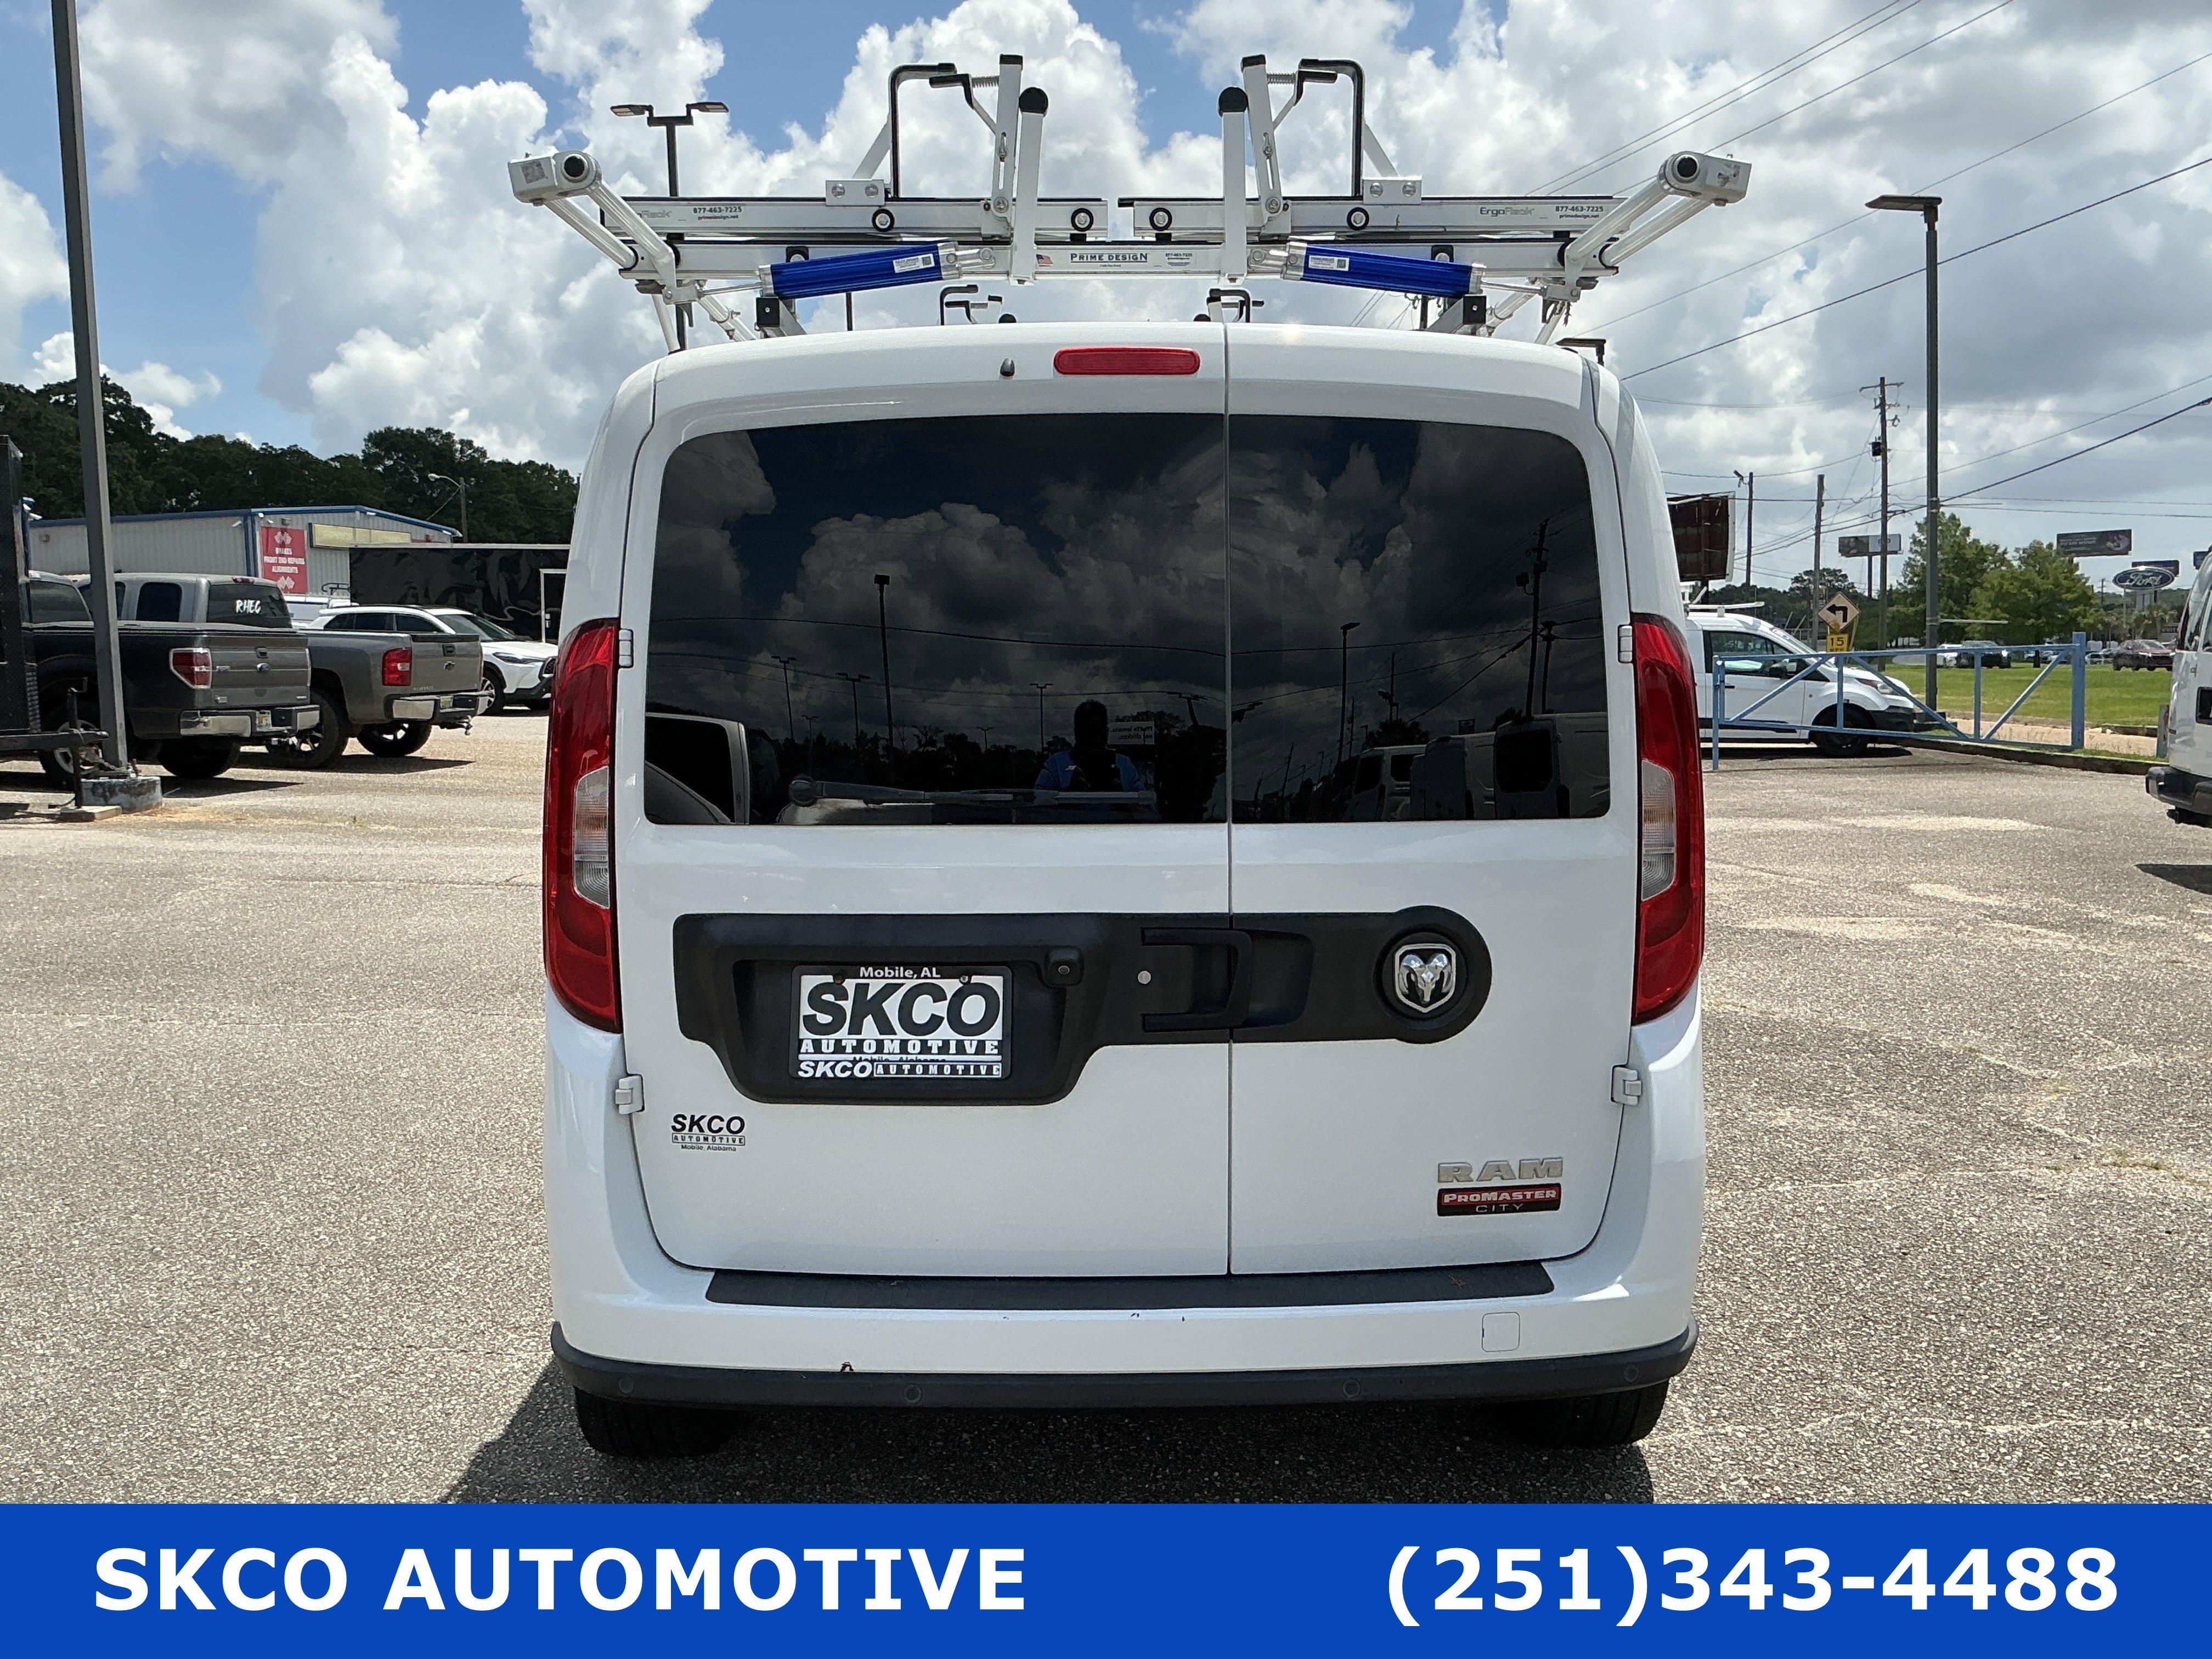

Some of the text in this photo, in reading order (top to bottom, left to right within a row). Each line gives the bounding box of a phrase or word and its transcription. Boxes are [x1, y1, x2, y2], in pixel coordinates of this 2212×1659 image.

[1070, 253, 1104, 261] PRIME
[1831, 637, 1844, 646] 15
[860, 966, 941, 979] Mobile, AL
[802, 981, 1000, 1036] SKCO
[800, 1039, 998, 1054] AUTOMOTIVE
[798, 1061, 1000, 1078] SKCO AUTOMOTIVE
[671, 1114, 745, 1135] SKCO
[674, 1135, 743, 1143] AUTOMOTIVE
[1438, 1156, 1563, 1183] RAM
[1475, 1203, 1523, 1213] CITY
